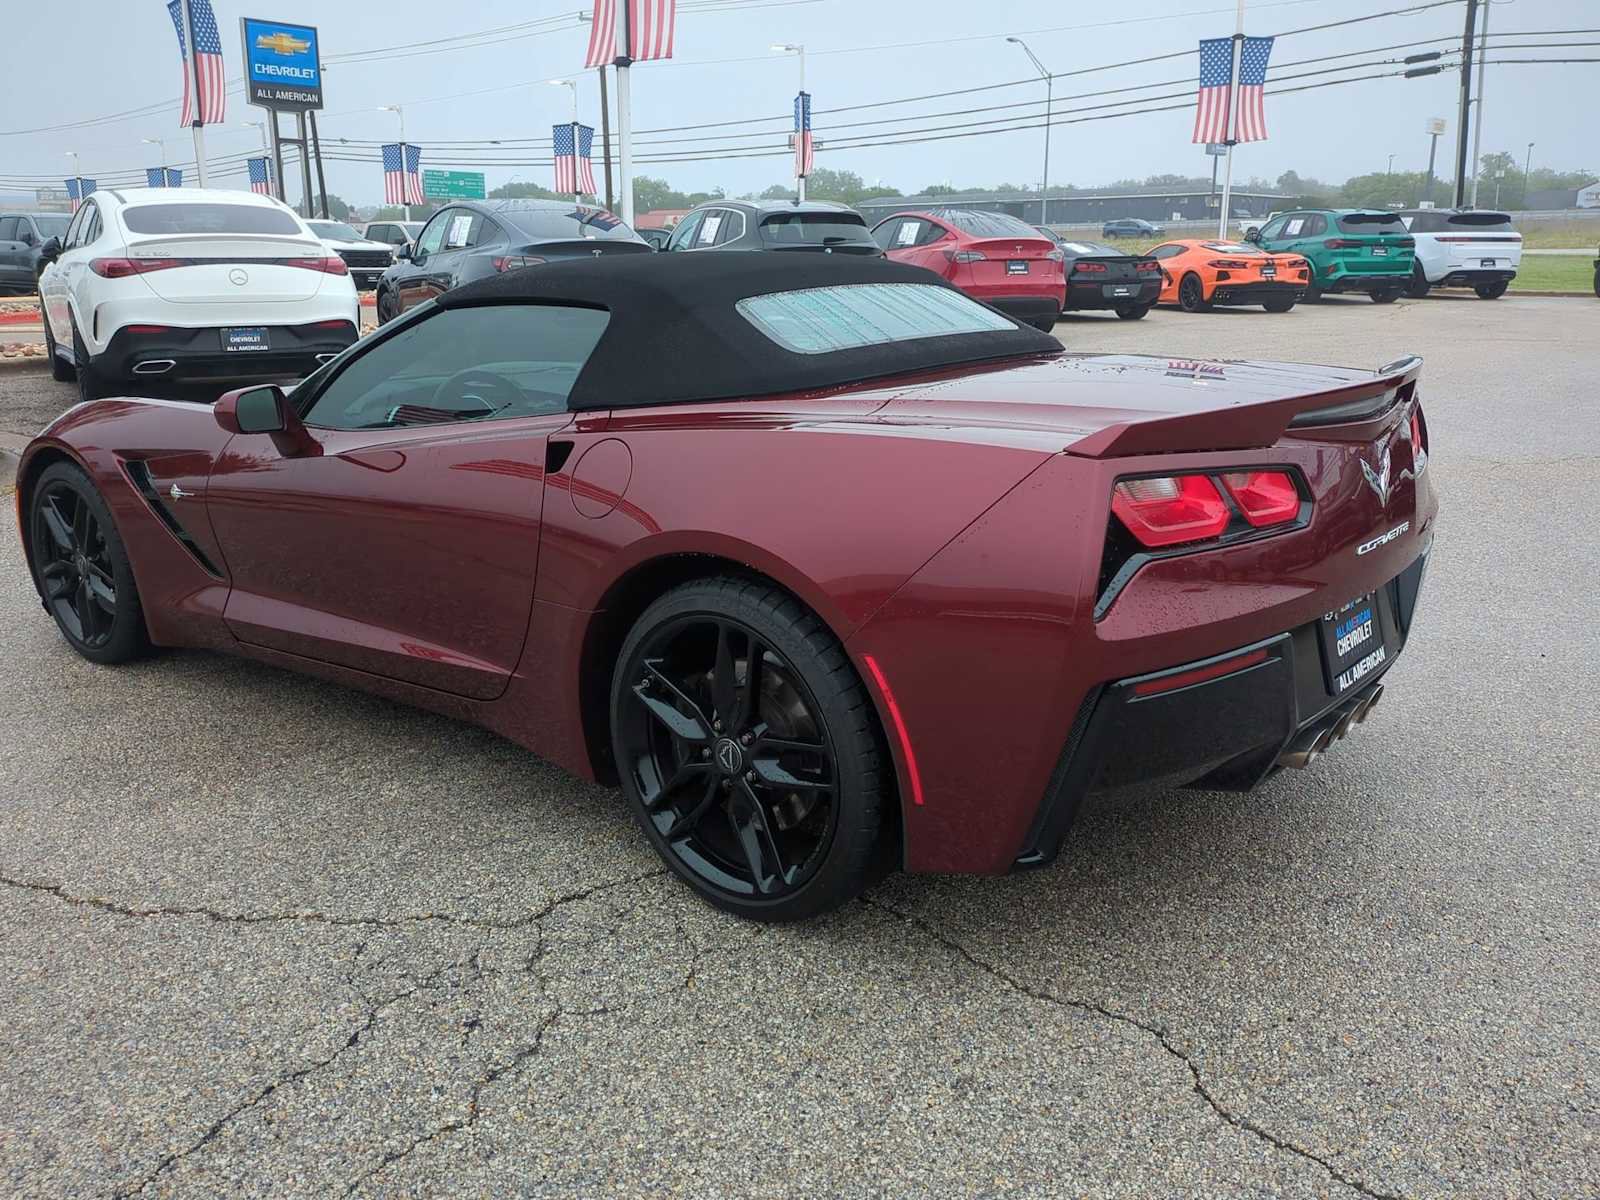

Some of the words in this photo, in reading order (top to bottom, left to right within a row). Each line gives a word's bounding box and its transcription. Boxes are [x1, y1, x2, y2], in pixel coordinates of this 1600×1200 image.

[255, 63, 315, 79] CHEVROLET
[257, 88, 273, 99] ALL
[275, 90, 319, 103] AMERICAN
[1358, 521, 1409, 555] CORVETTE
[1337, 620, 1373, 657] CHEVROLET
[1339, 670, 1354, 692] ALL
[1353, 645, 1386, 682] AMERICAN
